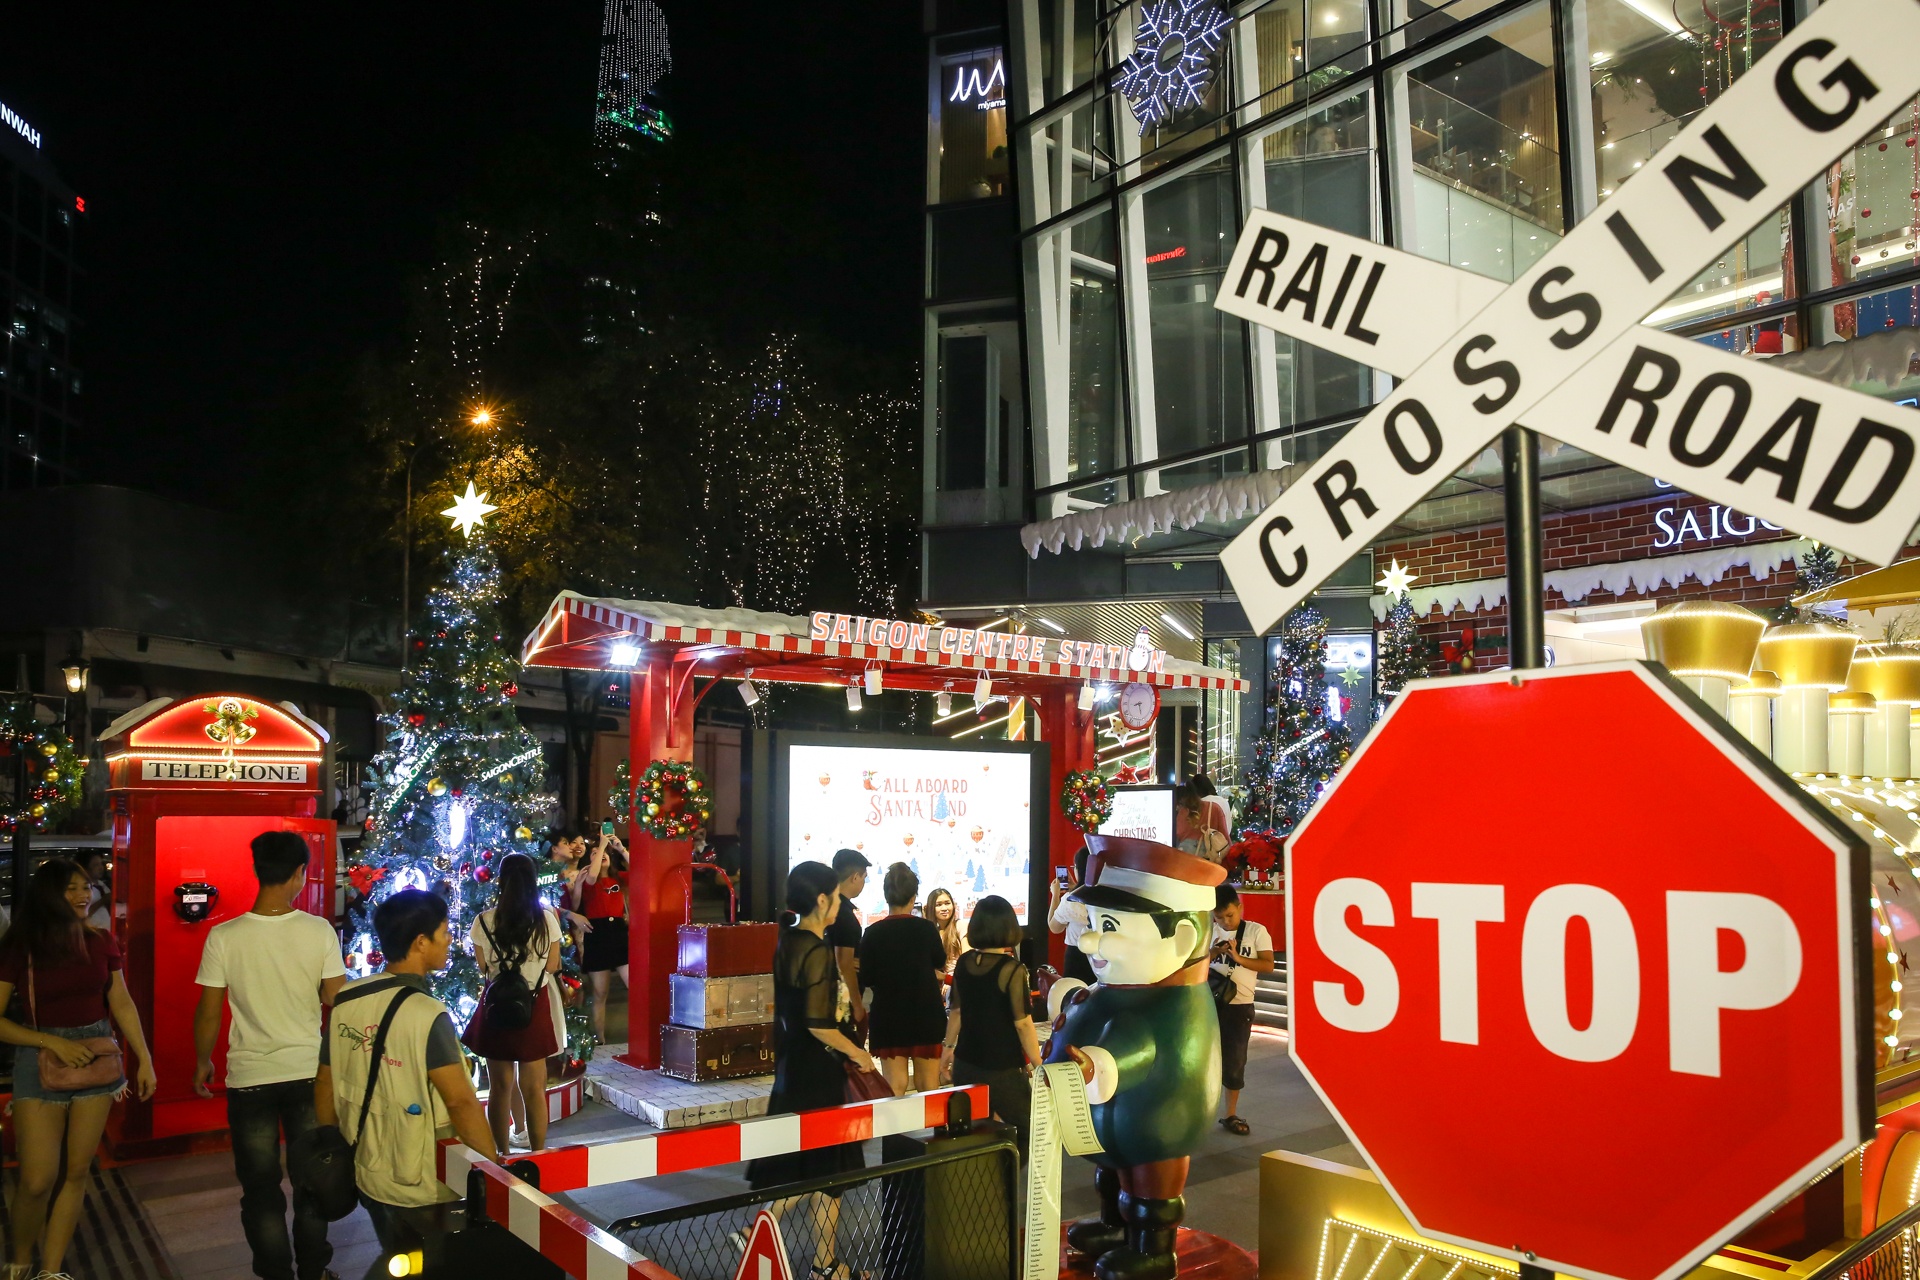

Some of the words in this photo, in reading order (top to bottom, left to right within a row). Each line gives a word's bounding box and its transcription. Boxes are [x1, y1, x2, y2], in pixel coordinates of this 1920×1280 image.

[0, 101, 41, 149] NWAH
[1234, 225, 1387, 346] RAIL
[1259, 38, 1880, 588] CROSSING
[1595, 345, 1916, 524] ROAD
[1654, 504, 1784, 548] SAIG
[811, 611, 931, 652] SAIGON
[939, 627, 1046, 663] CENTRE
[149, 763, 300, 780] TELEPHONE
[884, 778, 909, 793] ALL
[915, 778, 968, 794] ABOARD
[865, 794, 925, 827] SANTA
[1114, 826, 1157, 840] CHRISTMAS
[1313, 877, 1803, 1078] STOP
